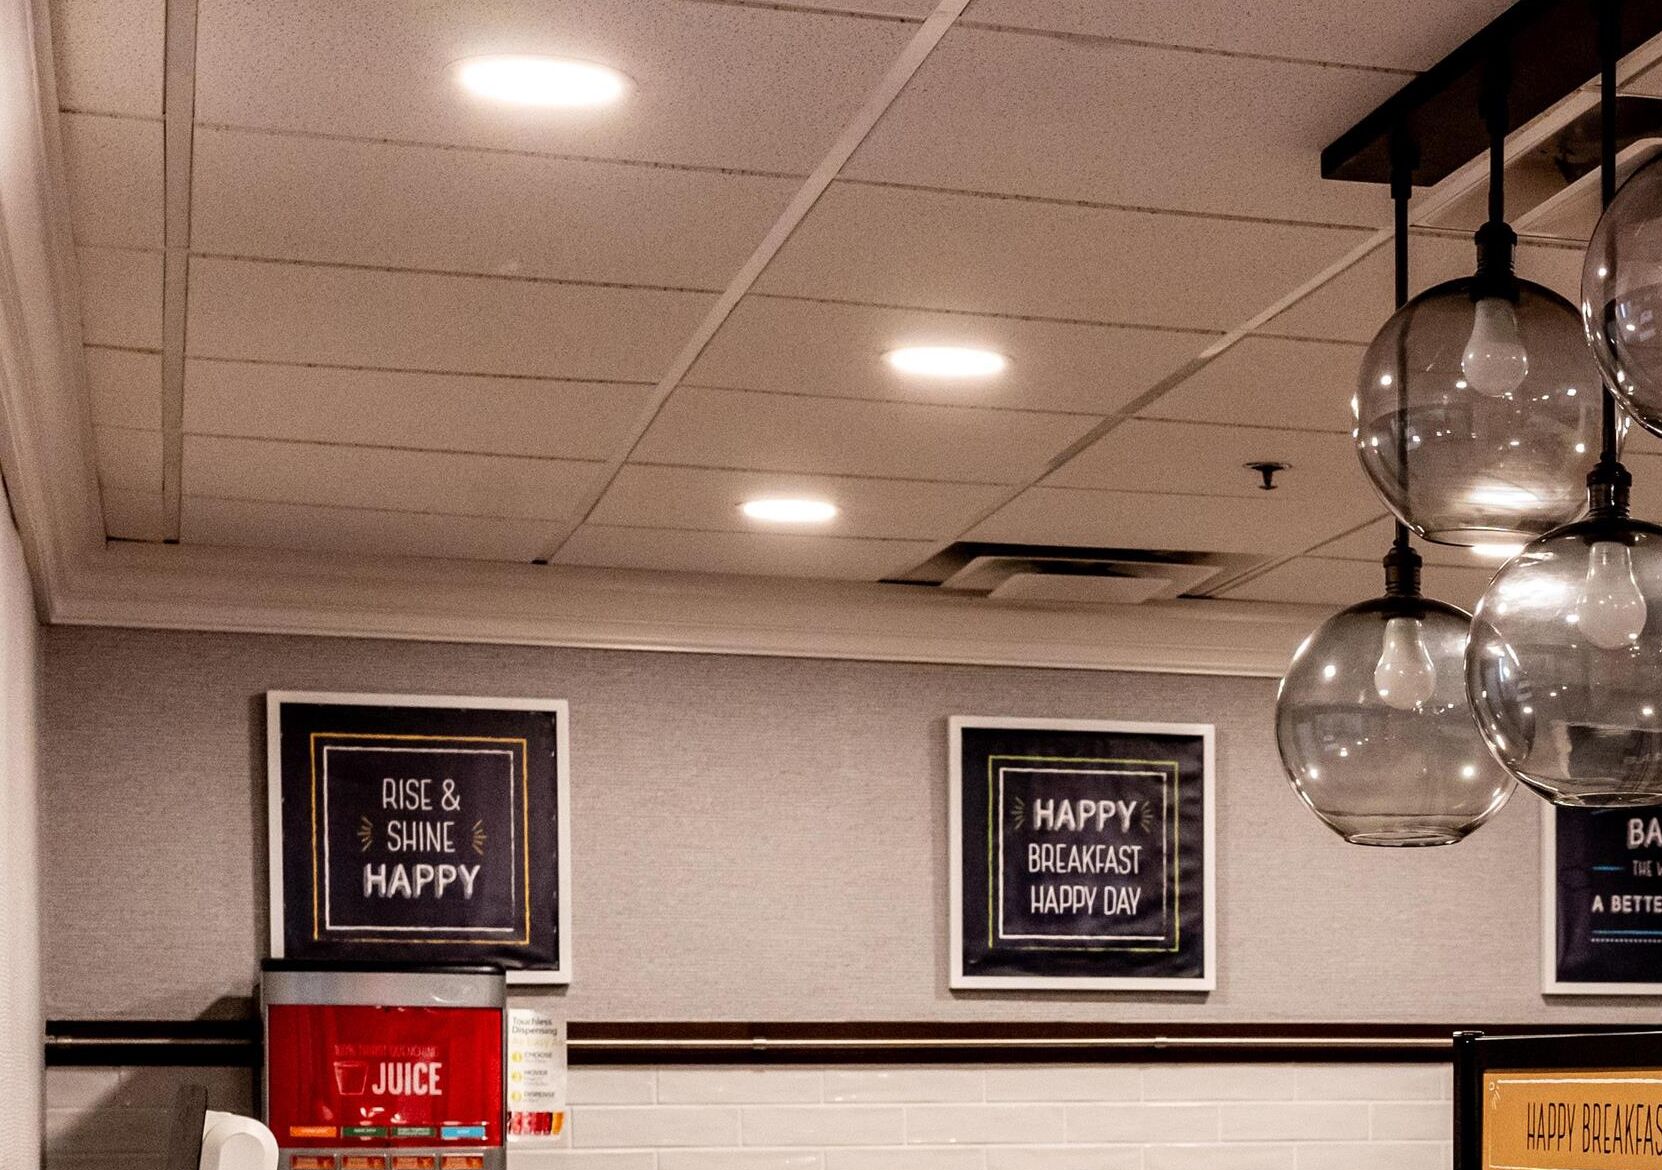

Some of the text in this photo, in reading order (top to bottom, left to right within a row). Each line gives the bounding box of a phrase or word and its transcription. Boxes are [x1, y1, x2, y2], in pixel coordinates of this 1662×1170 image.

[382, 778, 461, 811] RISE &
[1033, 799, 1137, 833] HAPPY
[387, 820, 455, 852] SHINE
[1028, 843, 1142, 874] BREAKFAST
[1632, 860, 1653, 877] THE
[363, 863, 480, 898] HAPPY
[1031, 885, 1141, 915] HAPPY DAY
[1592, 895, 1604, 913] A
[371, 1062, 442, 1095] JUICE
[1527, 1102, 1576, 1152] HAPPY
